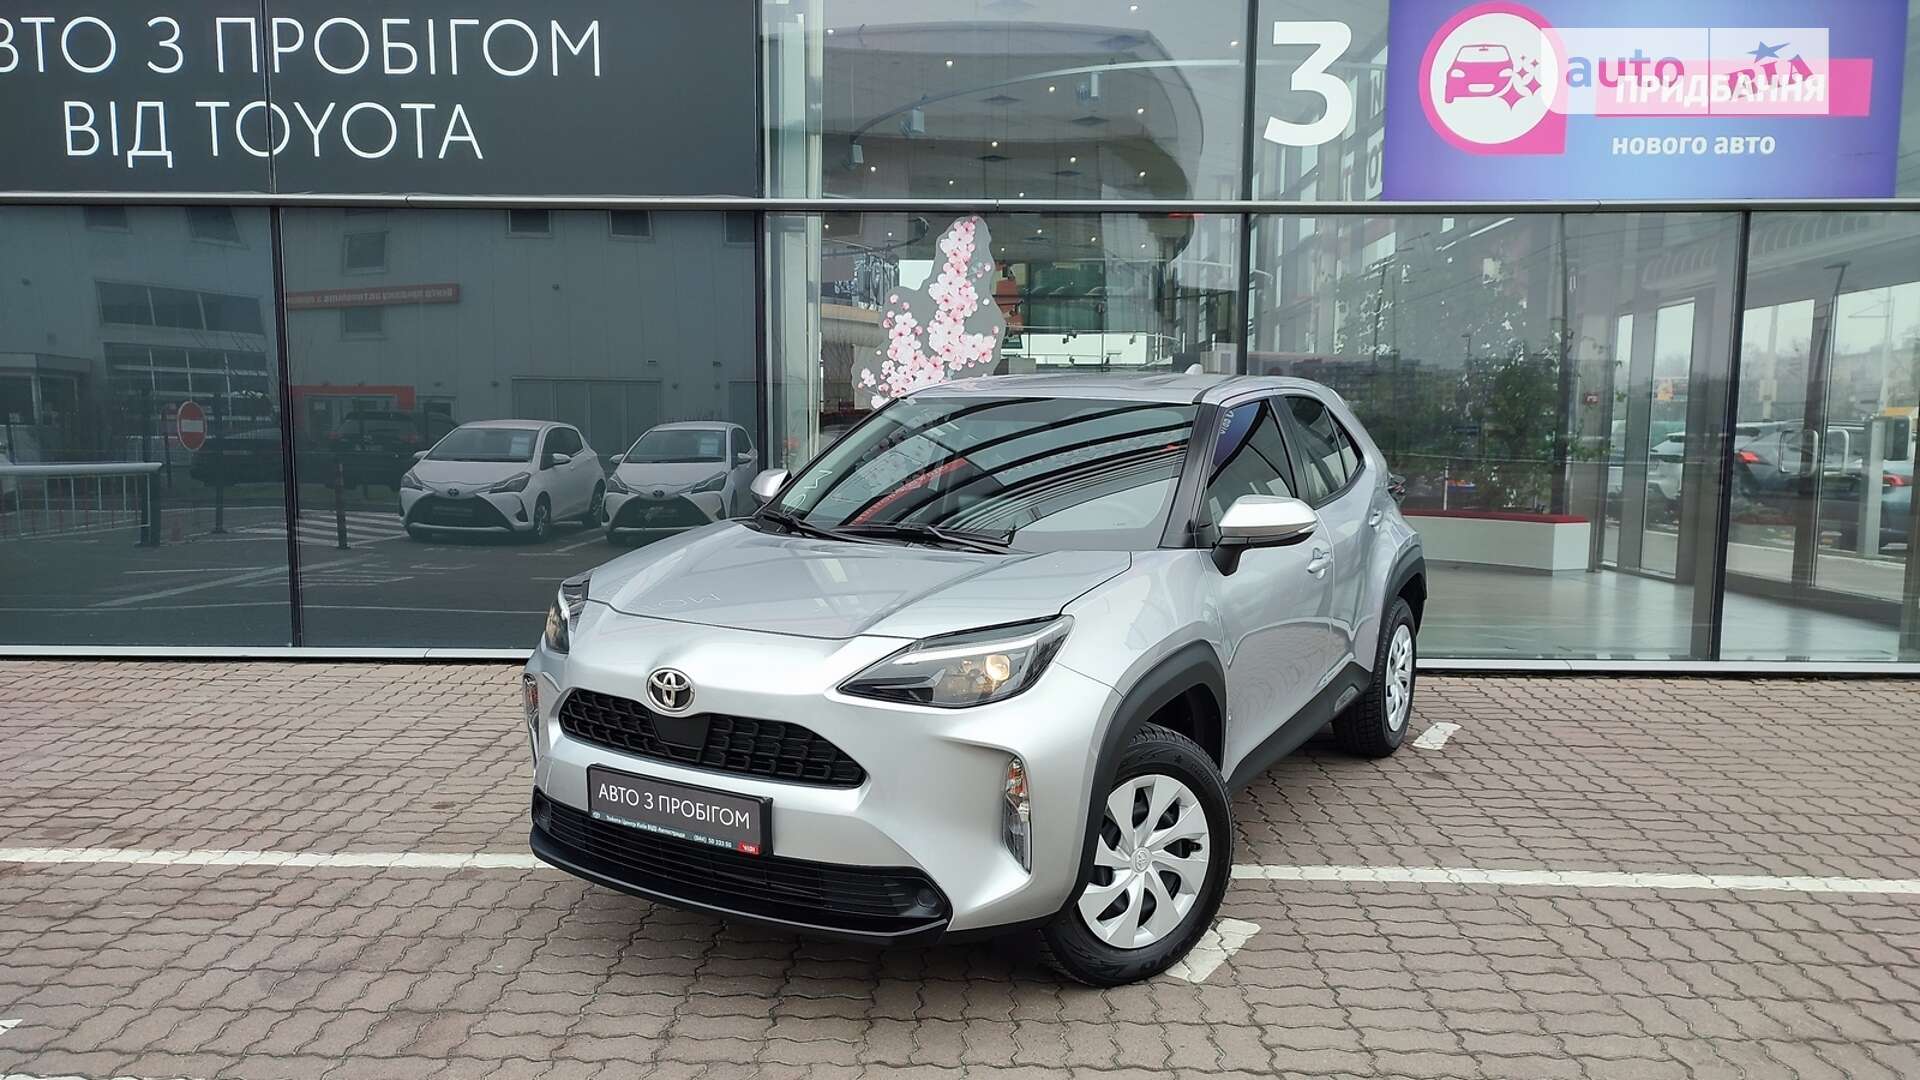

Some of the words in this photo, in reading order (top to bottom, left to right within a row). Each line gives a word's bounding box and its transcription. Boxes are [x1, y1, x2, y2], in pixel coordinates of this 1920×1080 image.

[215, 18, 600, 76] ПРОБІГОМ
[1615, 75, 1826, 108] ПРИДБАННЯ
[64, 101, 173, 168] ВІД
[195, 101, 484, 160] TOYOTA
[1611, 136, 1708, 156] нового
[1713, 136, 1777, 155] авто
[599, 784, 640, 806] АВТО
[658, 795, 750, 830] ПРОБІГОМ
